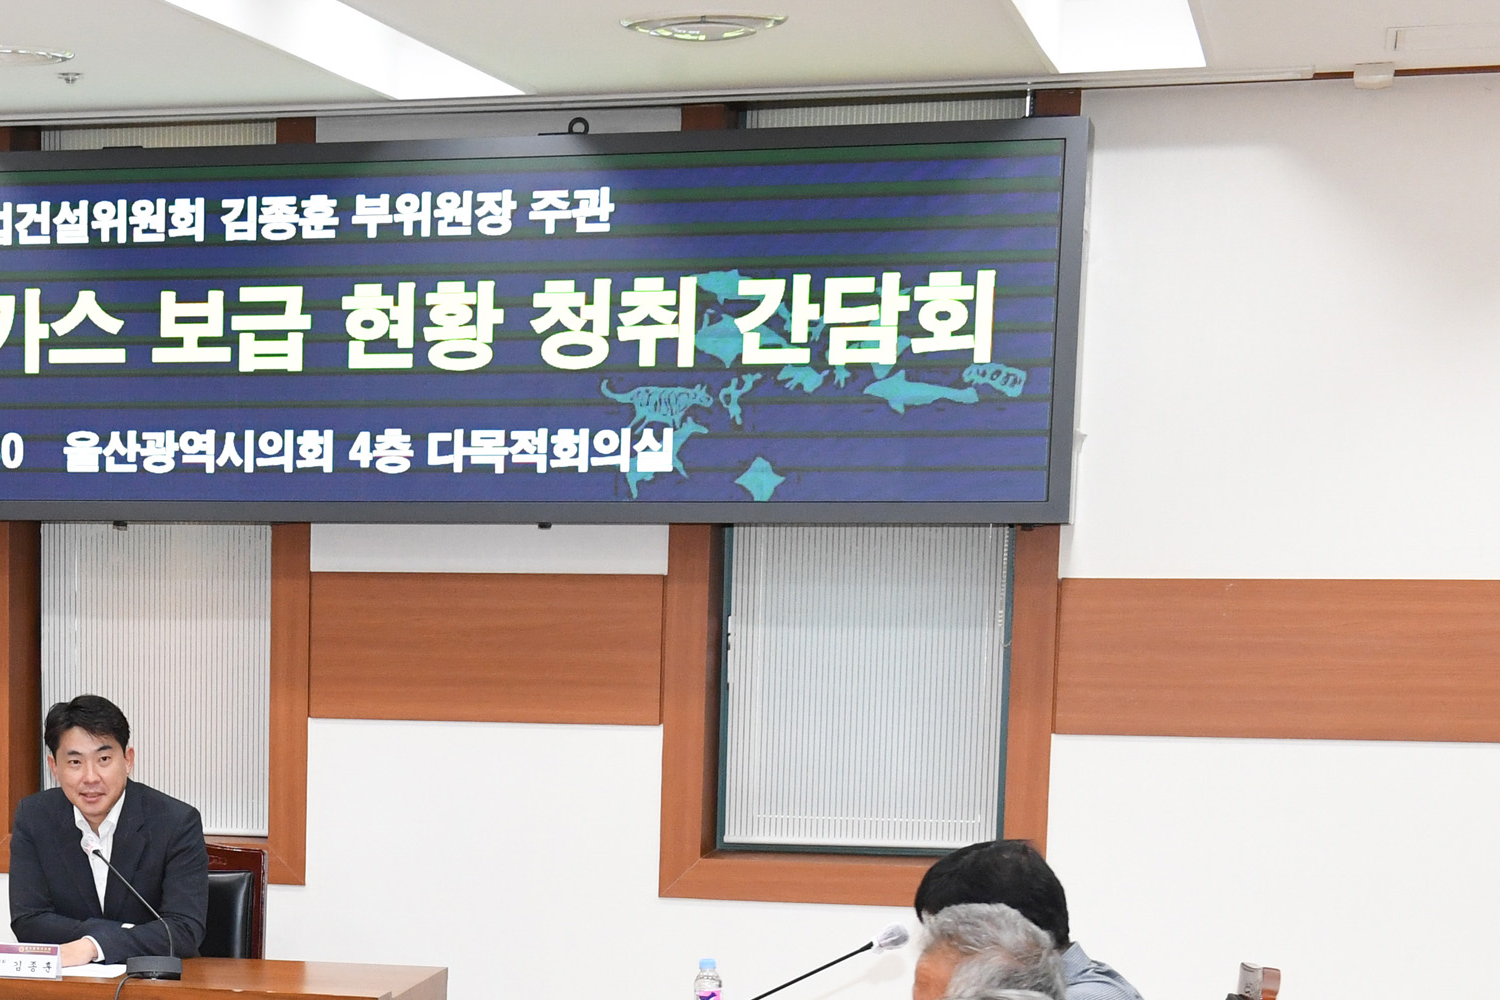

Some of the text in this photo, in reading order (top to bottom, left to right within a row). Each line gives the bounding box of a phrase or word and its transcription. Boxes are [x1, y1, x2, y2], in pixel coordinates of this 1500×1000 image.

[220, 194, 339, 241] 김종훈
[350, 189, 517, 239] 부위원장
[528, 186, 615, 235] 주관
[151, 286, 312, 372] 보급
[341, 280, 504, 371] 현황
[529, 276, 698, 370] 청취
[734, 269, 996, 366] 간담회
[62, 429, 334, 475] 울산광역시의회
[348, 428, 414, 474] 4층
[427, 427, 674, 475] 다목적회의실
